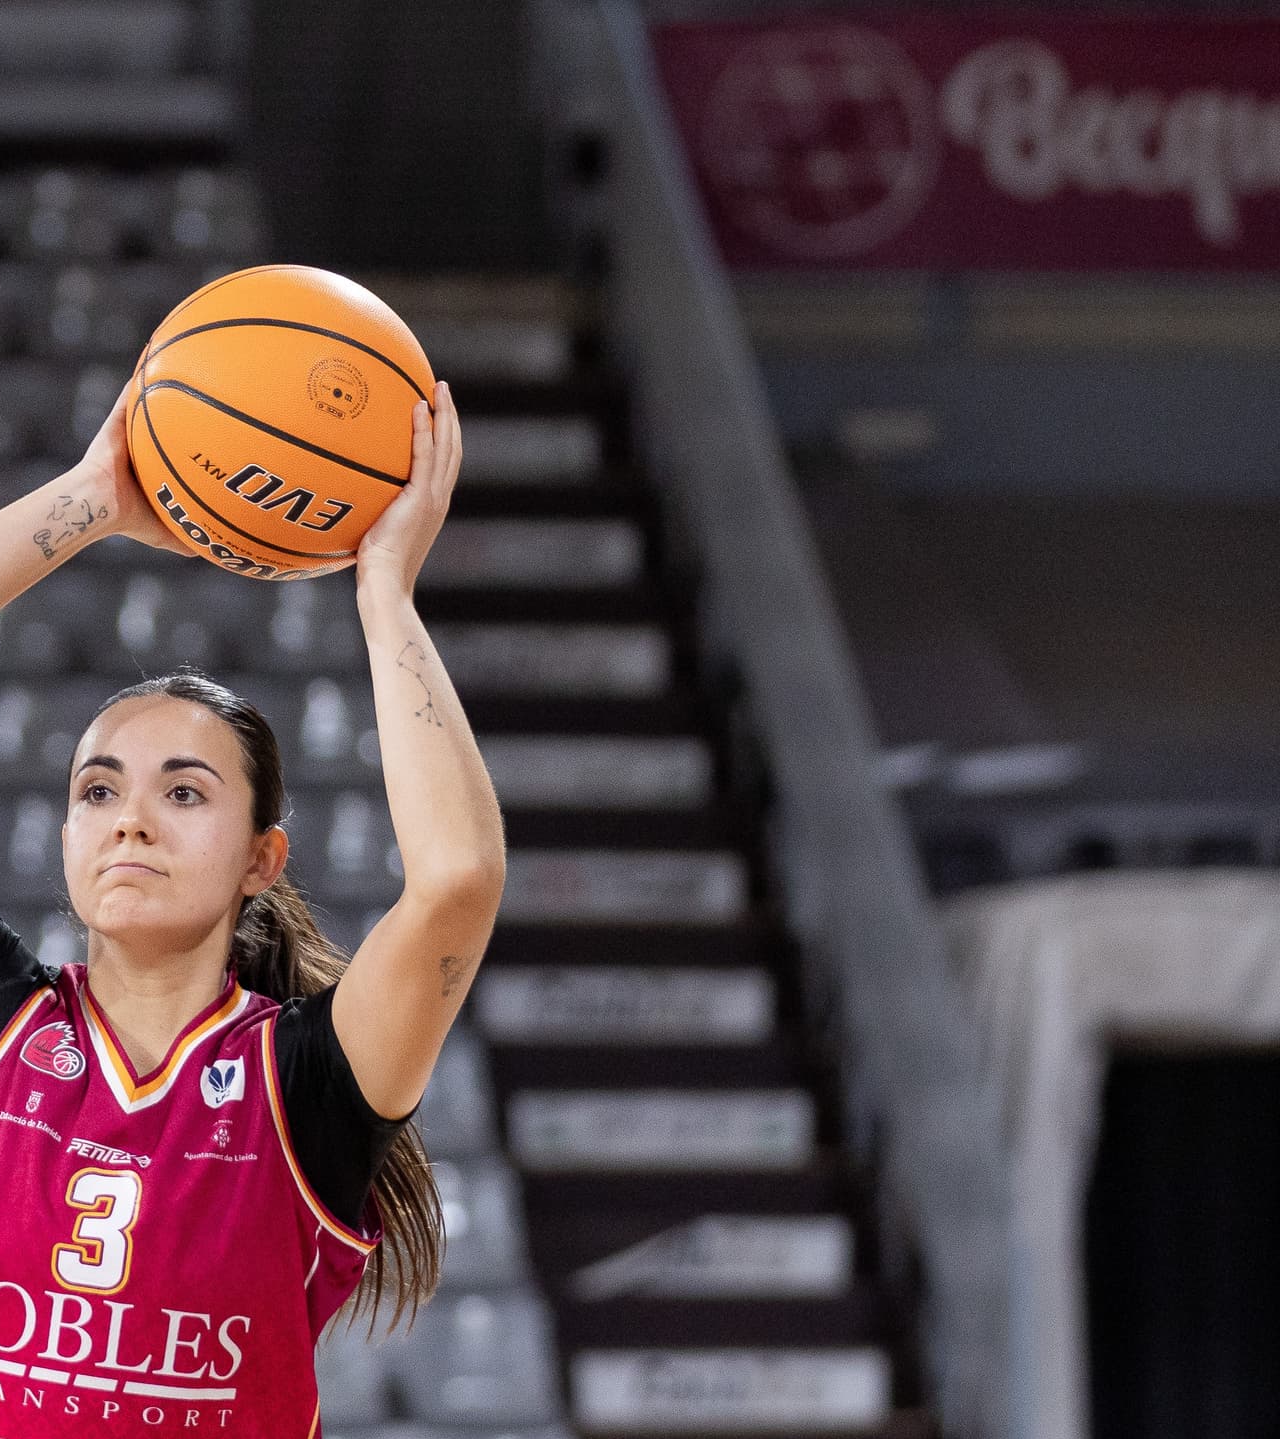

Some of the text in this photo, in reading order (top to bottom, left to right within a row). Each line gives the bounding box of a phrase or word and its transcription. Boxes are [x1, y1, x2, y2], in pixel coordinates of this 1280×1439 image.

[191, 453, 354, 533] EVO NXT
[234, 1152, 258, 1162] Lleida
[51, 1167, 143, 1295] 3
